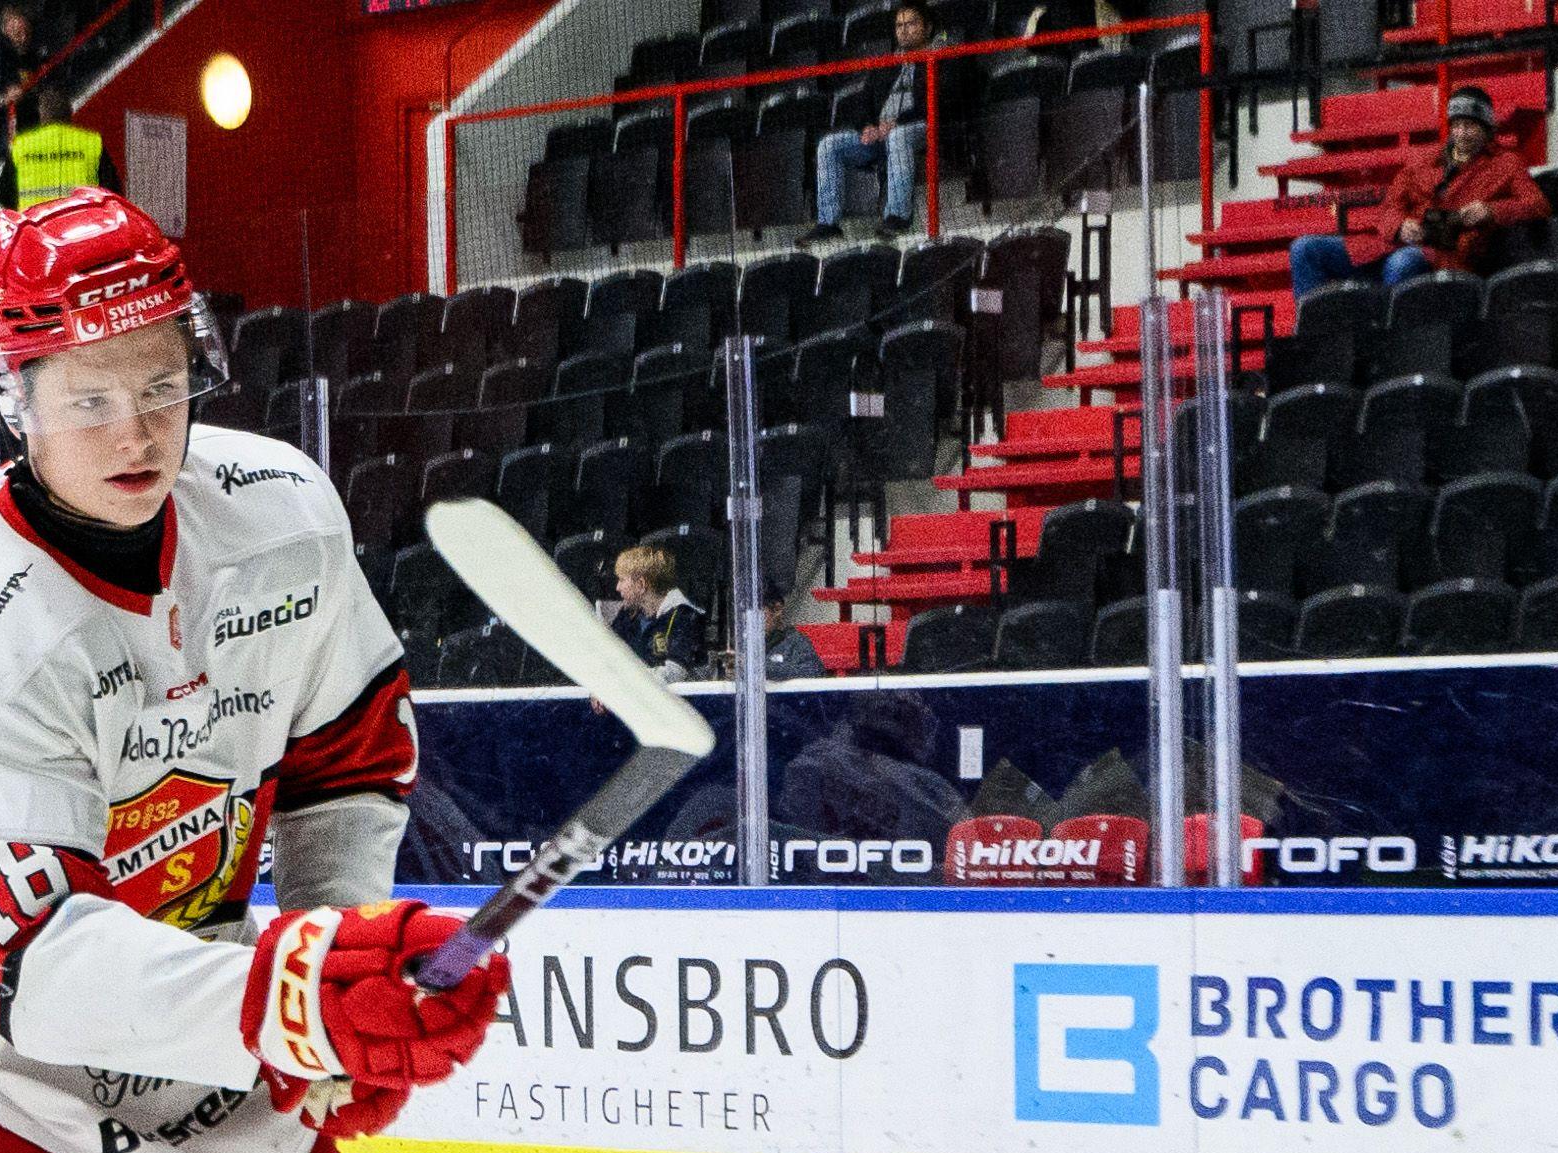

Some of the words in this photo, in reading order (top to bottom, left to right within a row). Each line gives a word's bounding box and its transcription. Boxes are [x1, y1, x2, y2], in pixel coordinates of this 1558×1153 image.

[78, 273, 150, 308] CCM
[109, 289, 173, 321] SVENSKA
[110, 314, 145, 335] SPEL
[214, 585, 320, 648] swedol
[969, 838, 1103, 867] HiKOKI
[279, 921, 328, 1073] CCM
[475, 1081, 772, 1132] FASTIGHETER
[1188, 1055, 1457, 1129] CARGO
